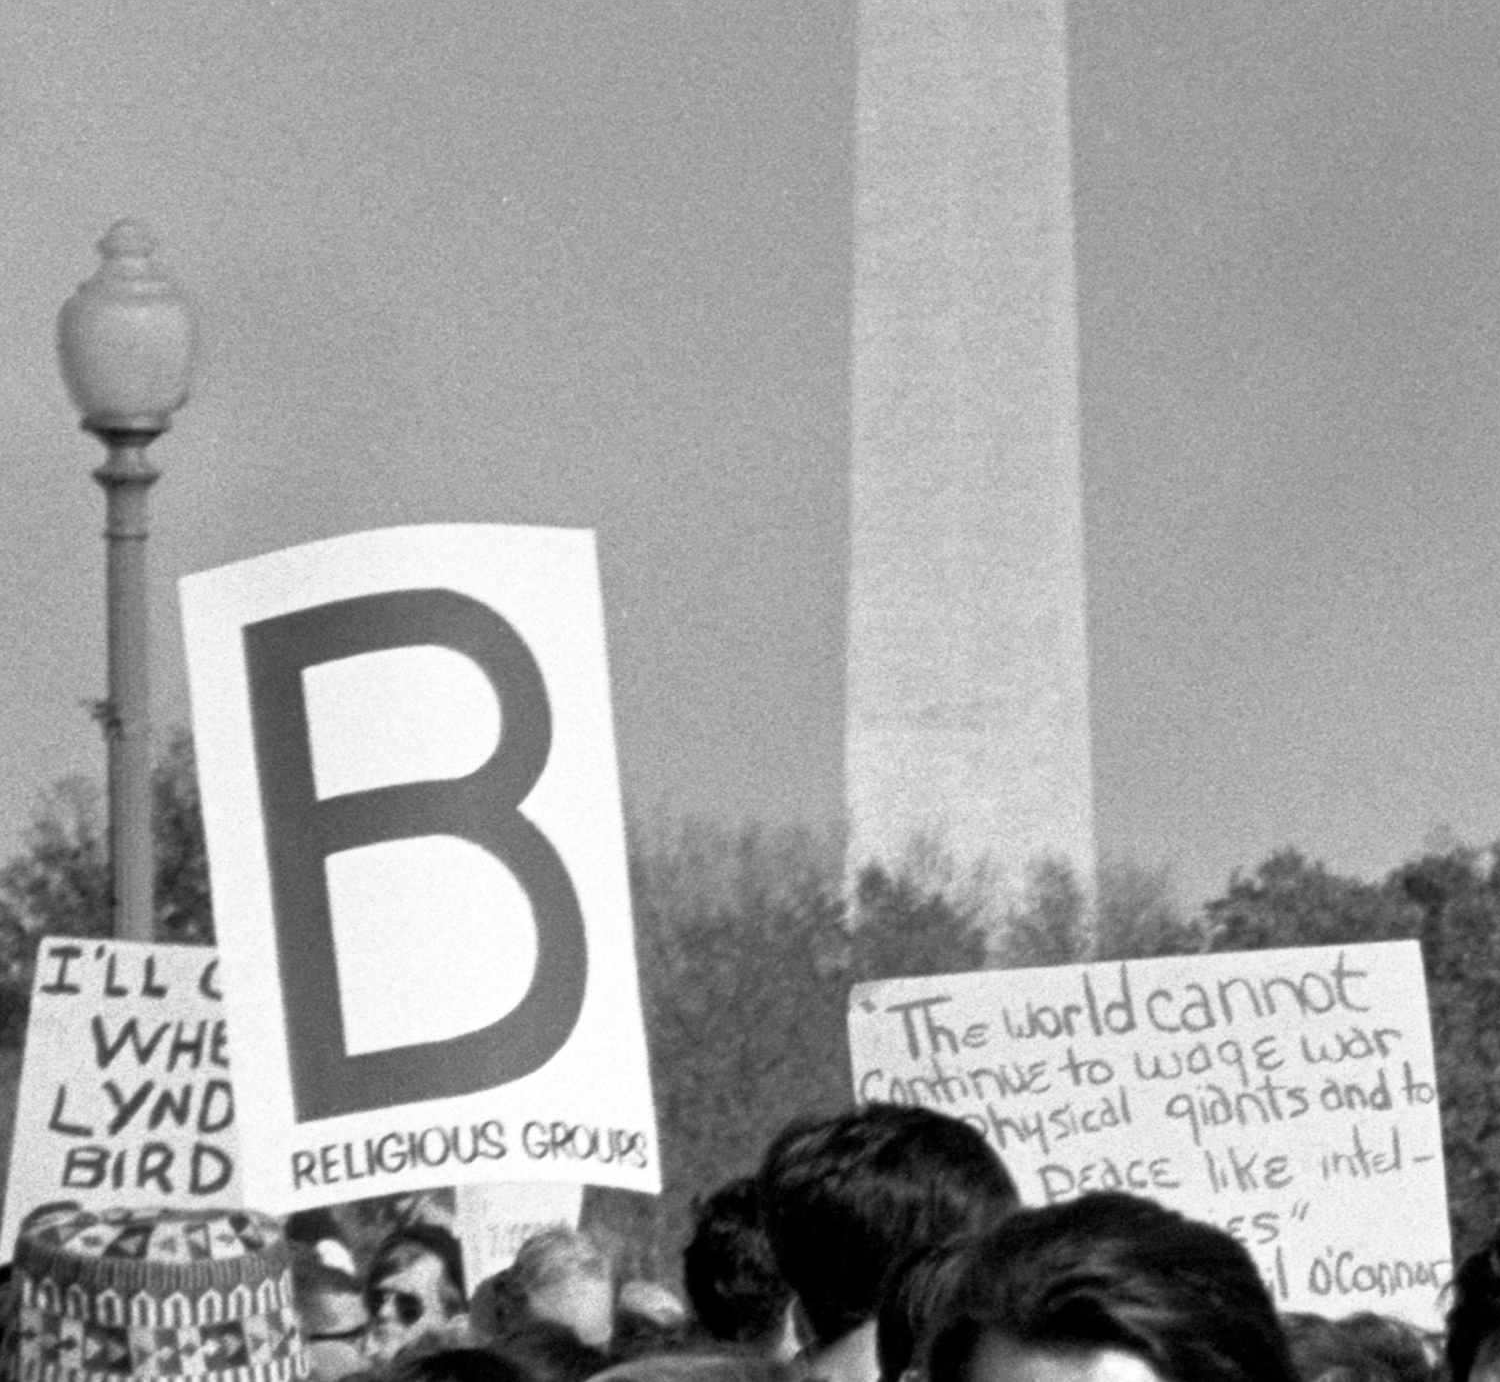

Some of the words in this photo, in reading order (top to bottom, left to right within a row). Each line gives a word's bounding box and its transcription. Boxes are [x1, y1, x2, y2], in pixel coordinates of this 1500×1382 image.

[242, 588, 588, 1124] B
[40, 944, 169, 999] I'LL
[1003, 962, 1136, 1039] world
[1145, 949, 1371, 1033] cannot
[1057, 1045, 1114, 1087] to
[1133, 1035, 1285, 1088] wage
[1301, 1027, 1402, 1064] war
[1164, 1073, 1309, 1147] giants
[1319, 1067, 1393, 1112] and
[1400, 1060, 1436, 1105] to
[60, 1142, 234, 1195] BIRD
[291, 1119, 507, 1189] RELIGIOUS
[521, 1120, 648, 1169] GROUPS
